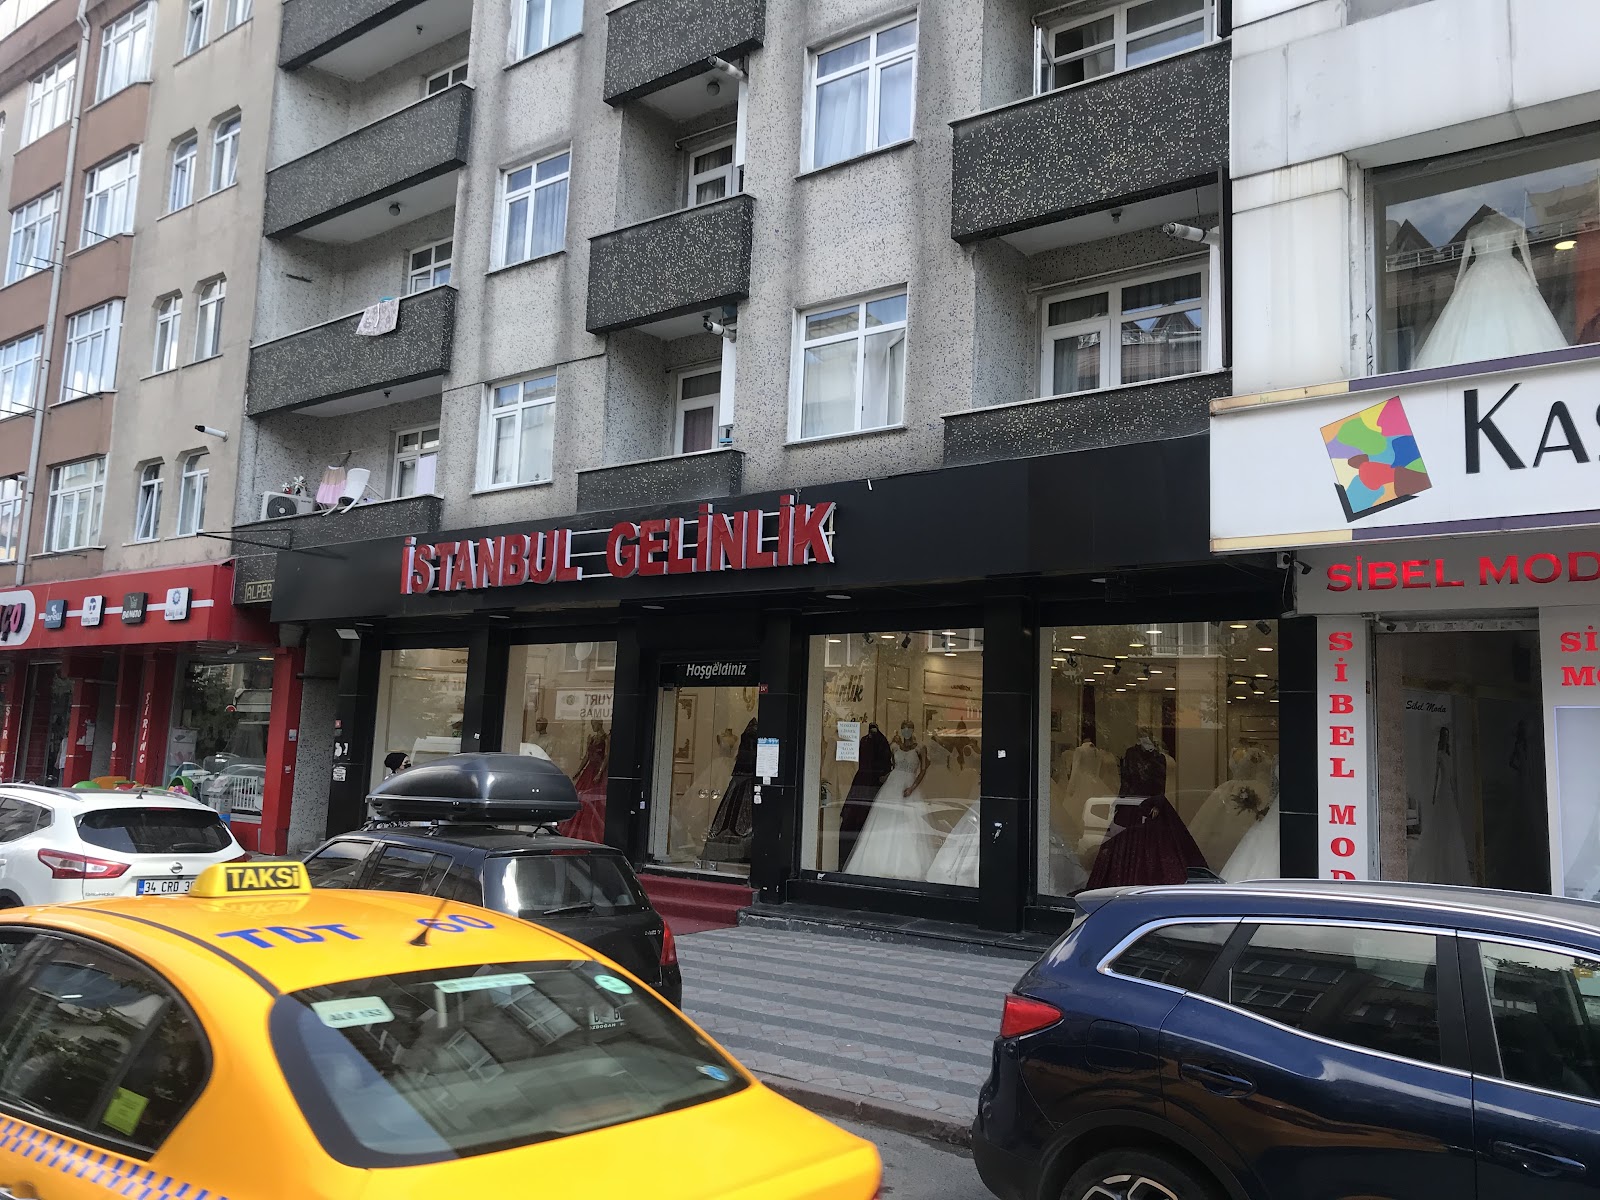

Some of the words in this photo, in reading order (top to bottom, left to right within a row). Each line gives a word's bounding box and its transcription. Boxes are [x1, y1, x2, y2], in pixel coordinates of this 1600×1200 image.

[1464, 382, 1600, 474] KA
[400, 529, 583, 594] İSTANBUL
[606, 494, 836, 578] GELİNLİK
[1327, 556, 1464, 592] SİBEL
[686, 662, 747, 680] Hoşgeldiniz
[1561, 666, 1600, 687] M
[1328, 631, 1356, 779] SİBEL
[1405, 700, 1425, 711] Sibel
[1425, 702, 1447, 713] Moda
[144, 881, 157, 893] 34
[161, 881, 180, 893] CRD
[216, 923, 362, 949] TDT
[417, 914, 496, 933] 60
